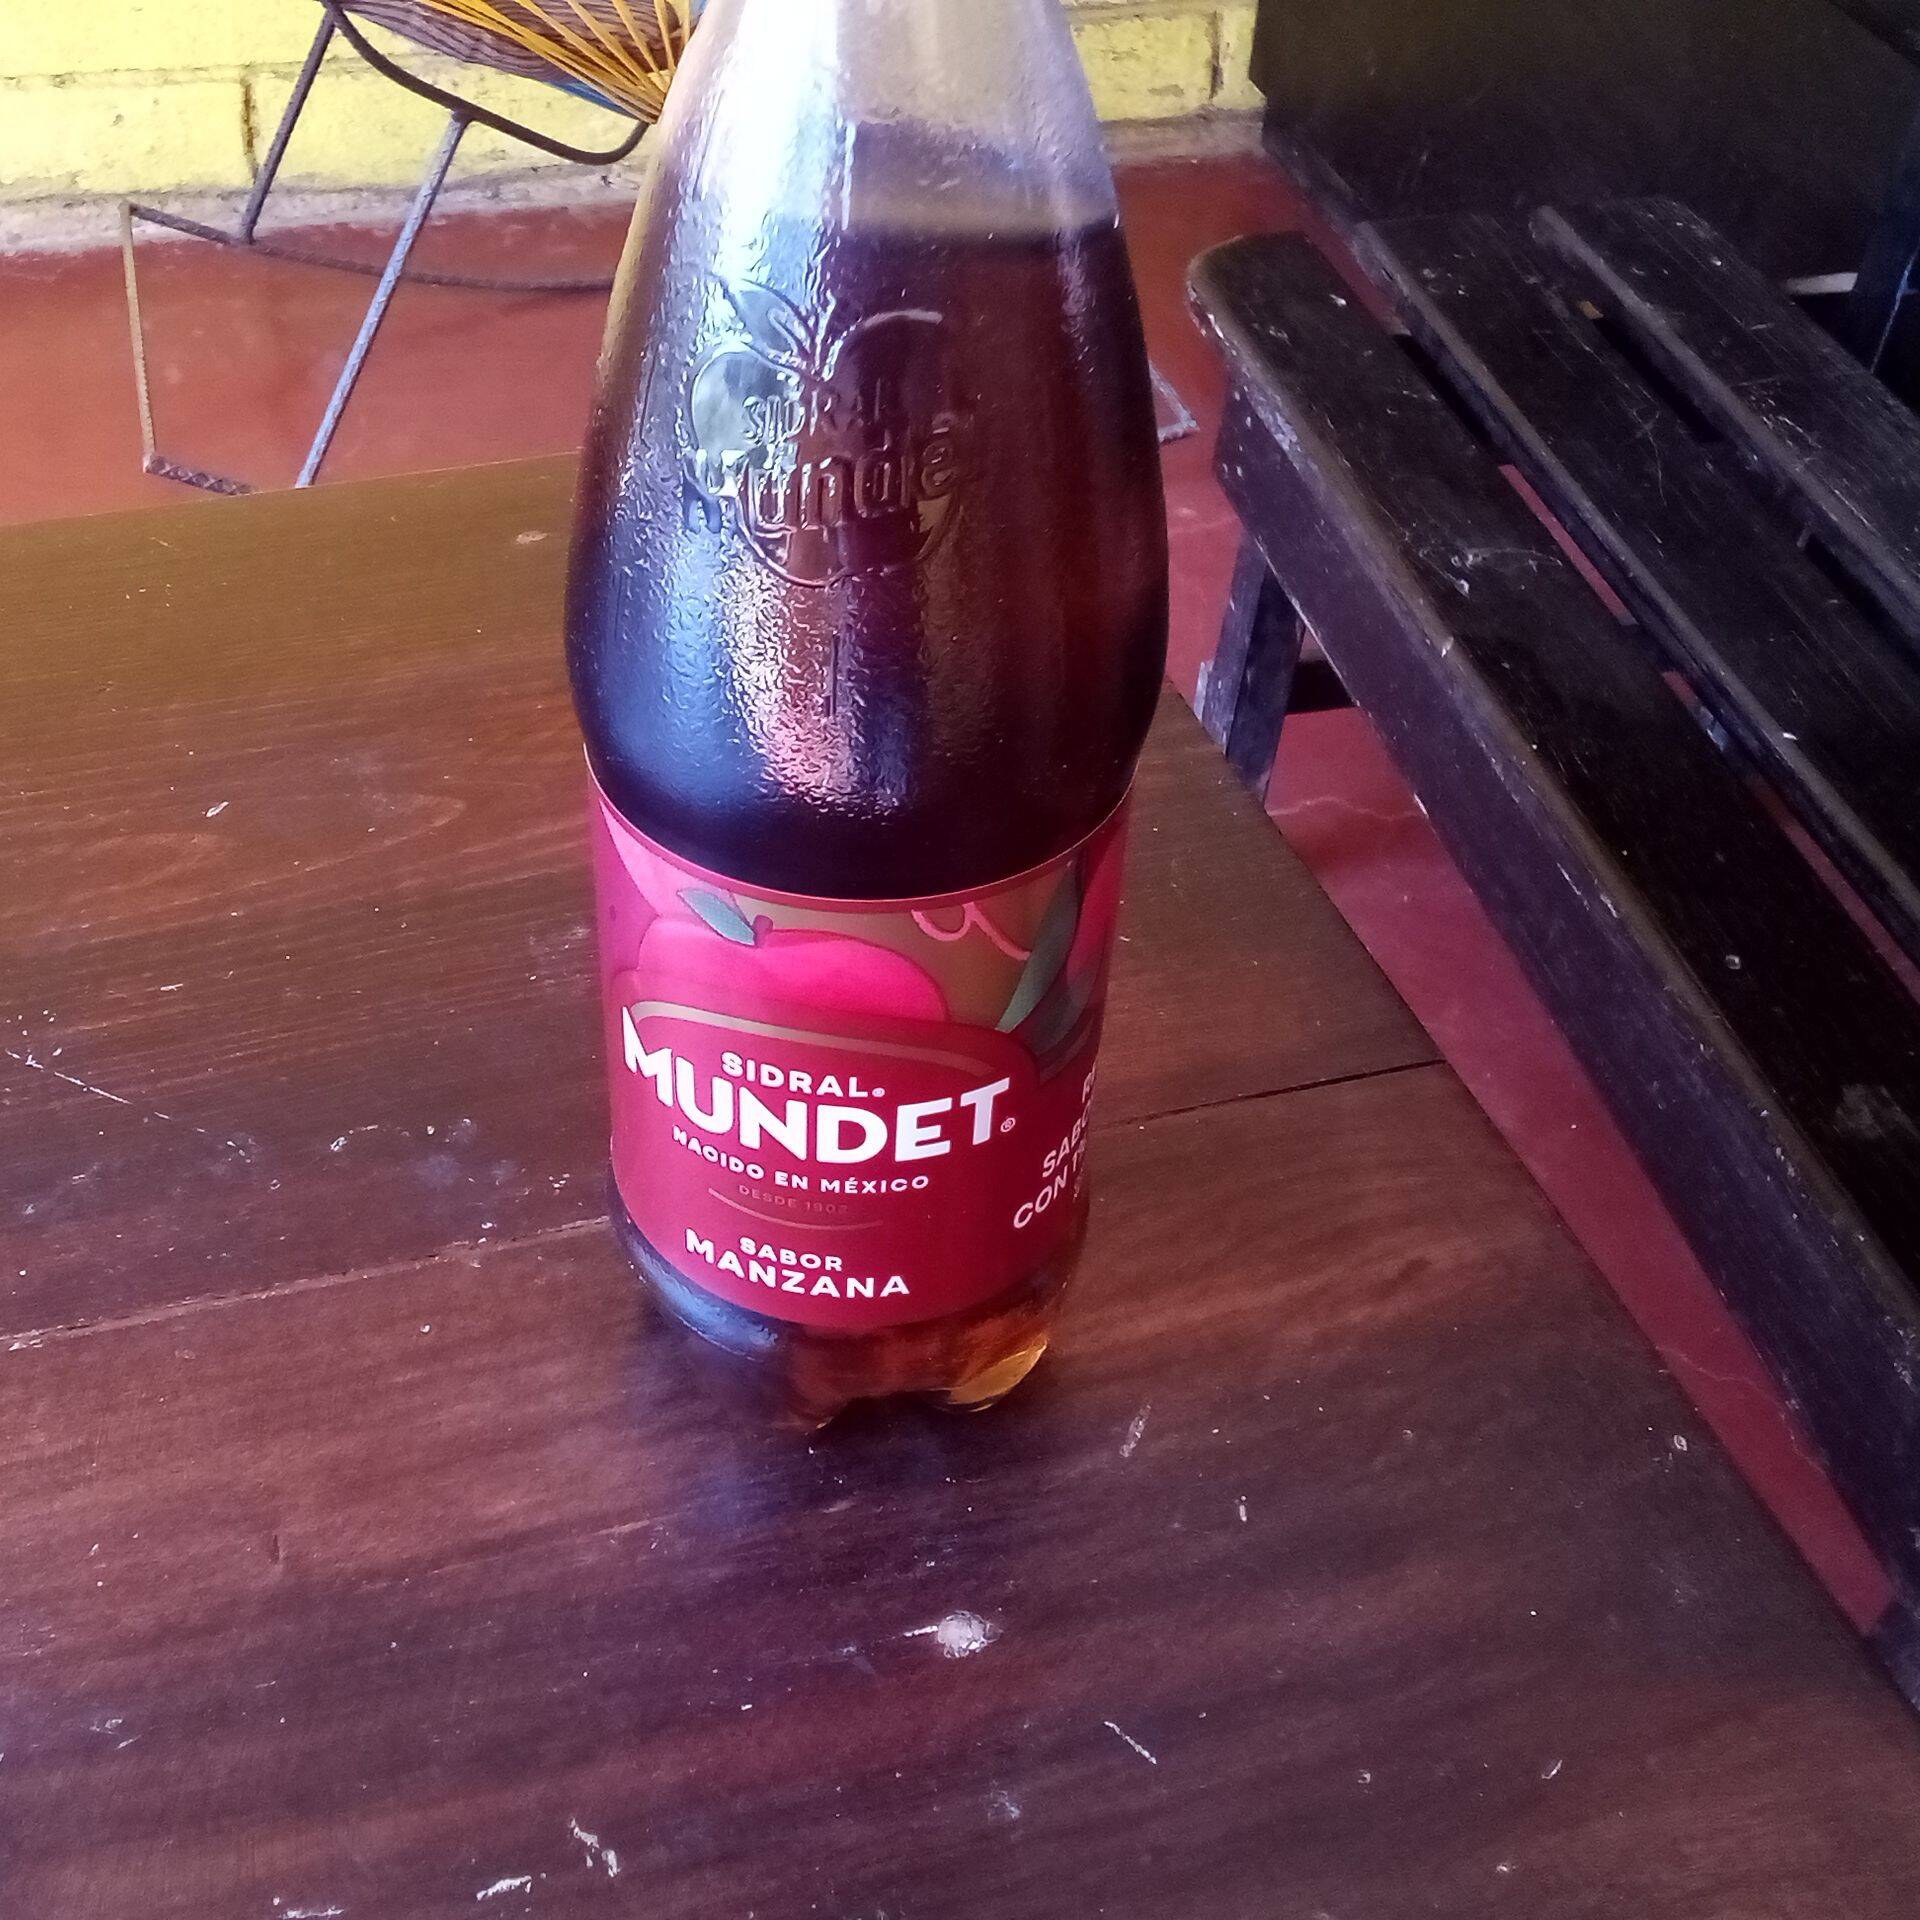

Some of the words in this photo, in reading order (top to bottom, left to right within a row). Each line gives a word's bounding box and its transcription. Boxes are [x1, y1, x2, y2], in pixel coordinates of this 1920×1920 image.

[622, 1006, 1013, 1165] MUNDET
[721, 1051, 870, 1099] SIDRAL
[672, 1126, 765, 1181] NACIDO
[774, 1171, 809, 1193] EN
[820, 1174, 930, 1195] MÉXICO
[737, 1184, 798, 1212] DESDE
[1013, 1164, 1069, 1229] CON
[684, 1228, 910, 1299] MANZANA
[739, 1236, 843, 1273] SABOR
